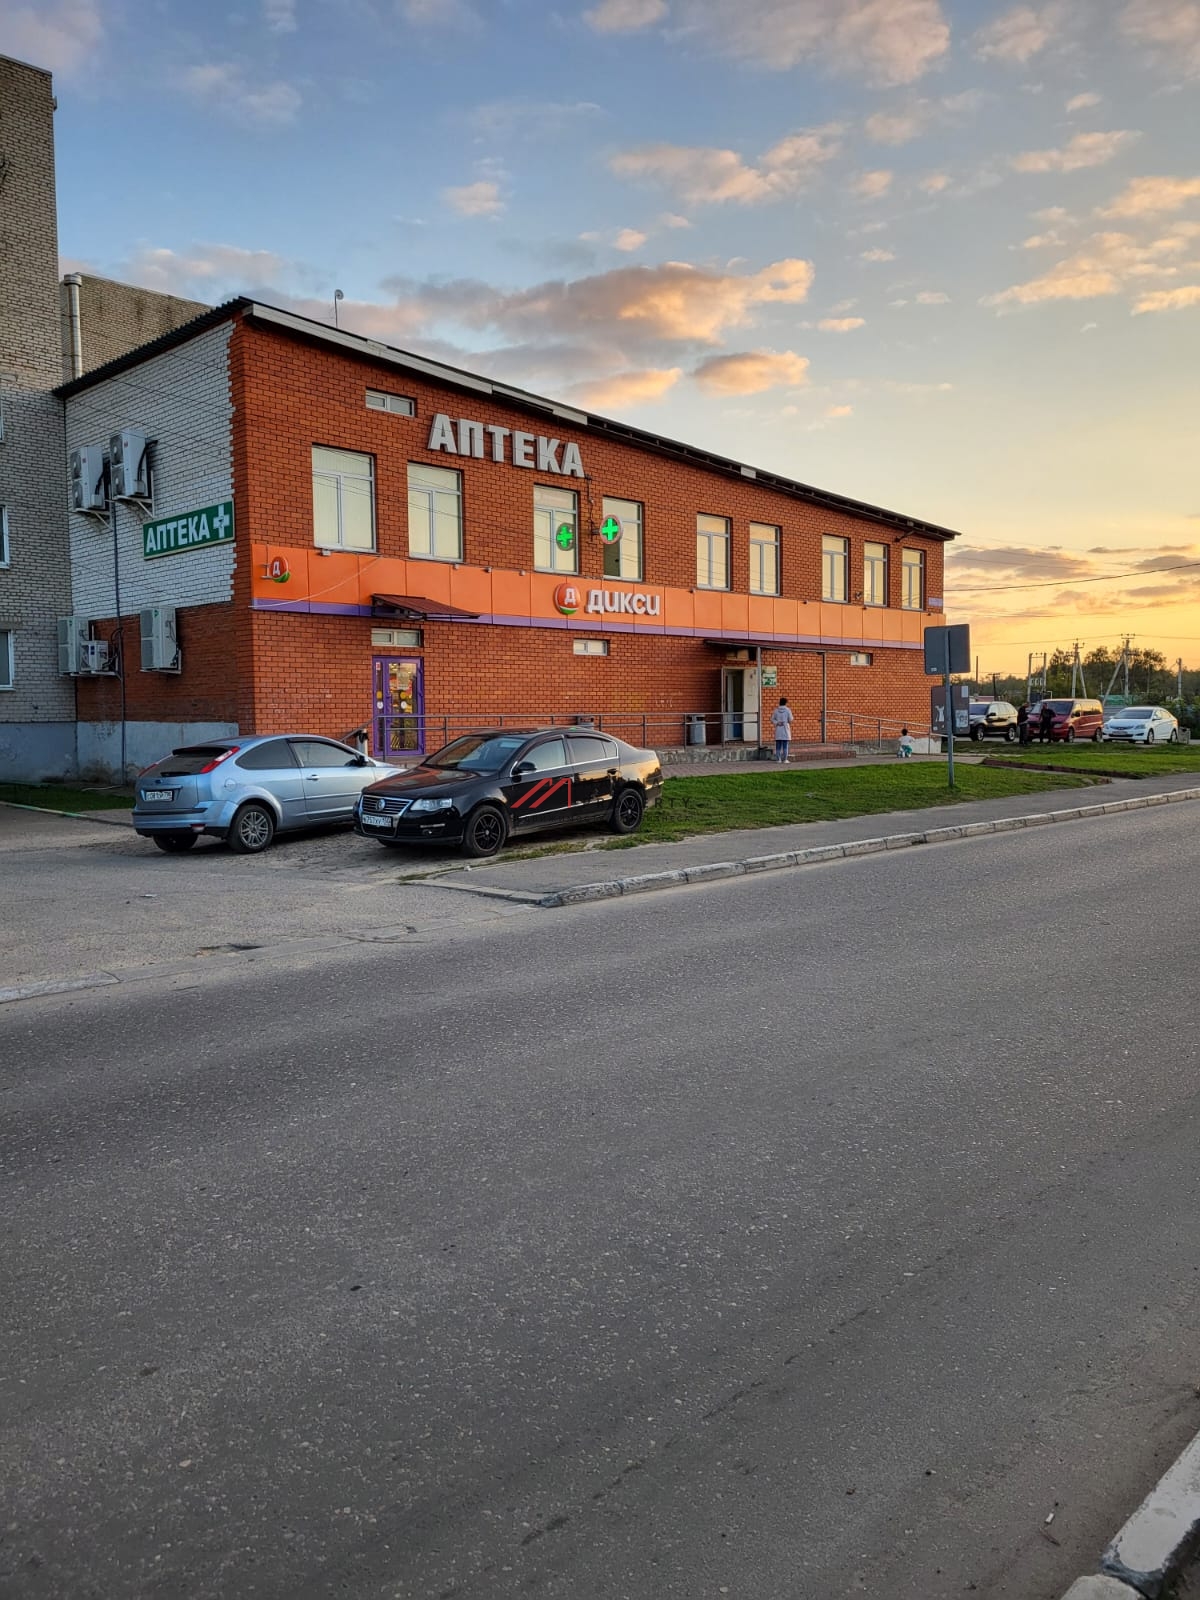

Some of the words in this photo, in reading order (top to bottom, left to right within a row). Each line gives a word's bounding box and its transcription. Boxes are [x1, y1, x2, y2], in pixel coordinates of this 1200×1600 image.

[427, 413, 586, 478] АПТЕКА
[145, 513, 211, 553] АПТЕКА
[564, 587, 577, 606] Д
